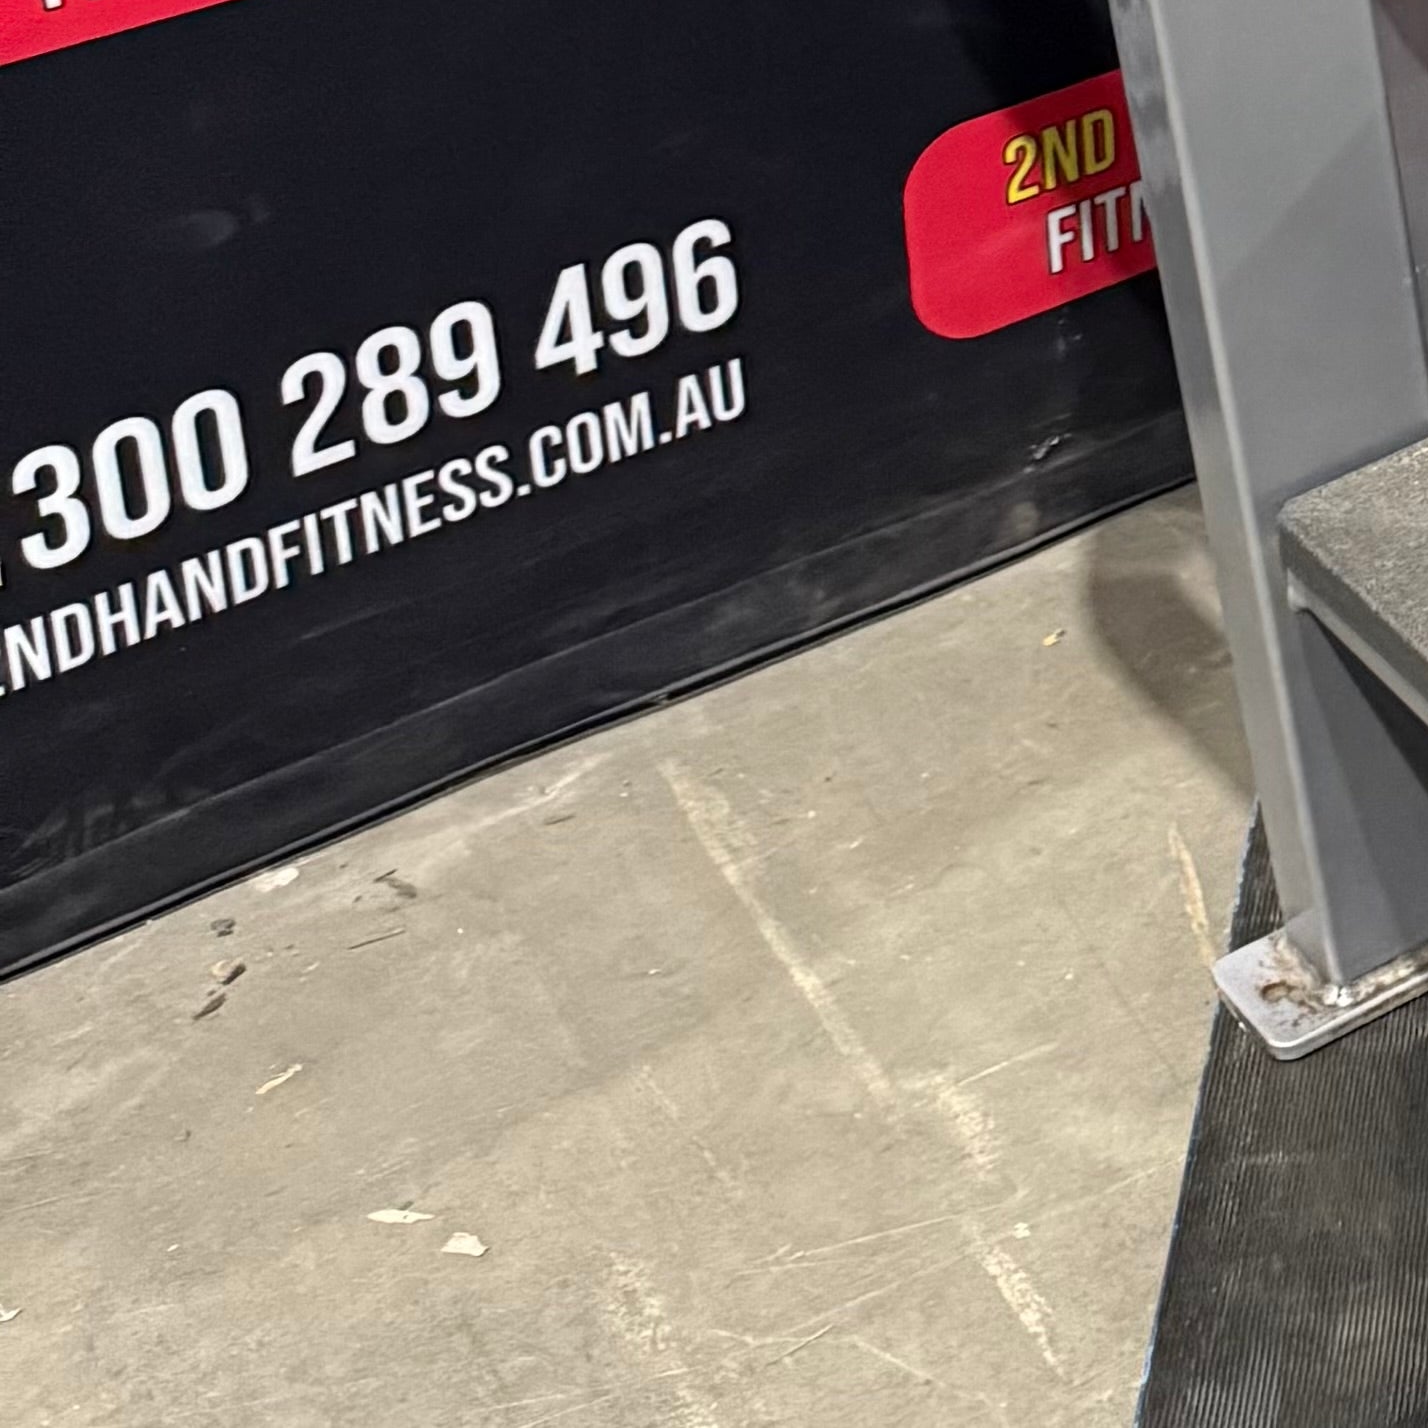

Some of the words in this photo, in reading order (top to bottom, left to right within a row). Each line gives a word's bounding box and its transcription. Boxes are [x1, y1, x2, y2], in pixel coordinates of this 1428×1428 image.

[1003, 108, 1116, 205] 2ND
[0, 388, 250, 584] 300
[280, 301, 501, 478] 289
[534, 217, 739, 376] 496
[0, 357, 747, 696] NDHANDFITNESS.COM.AU
